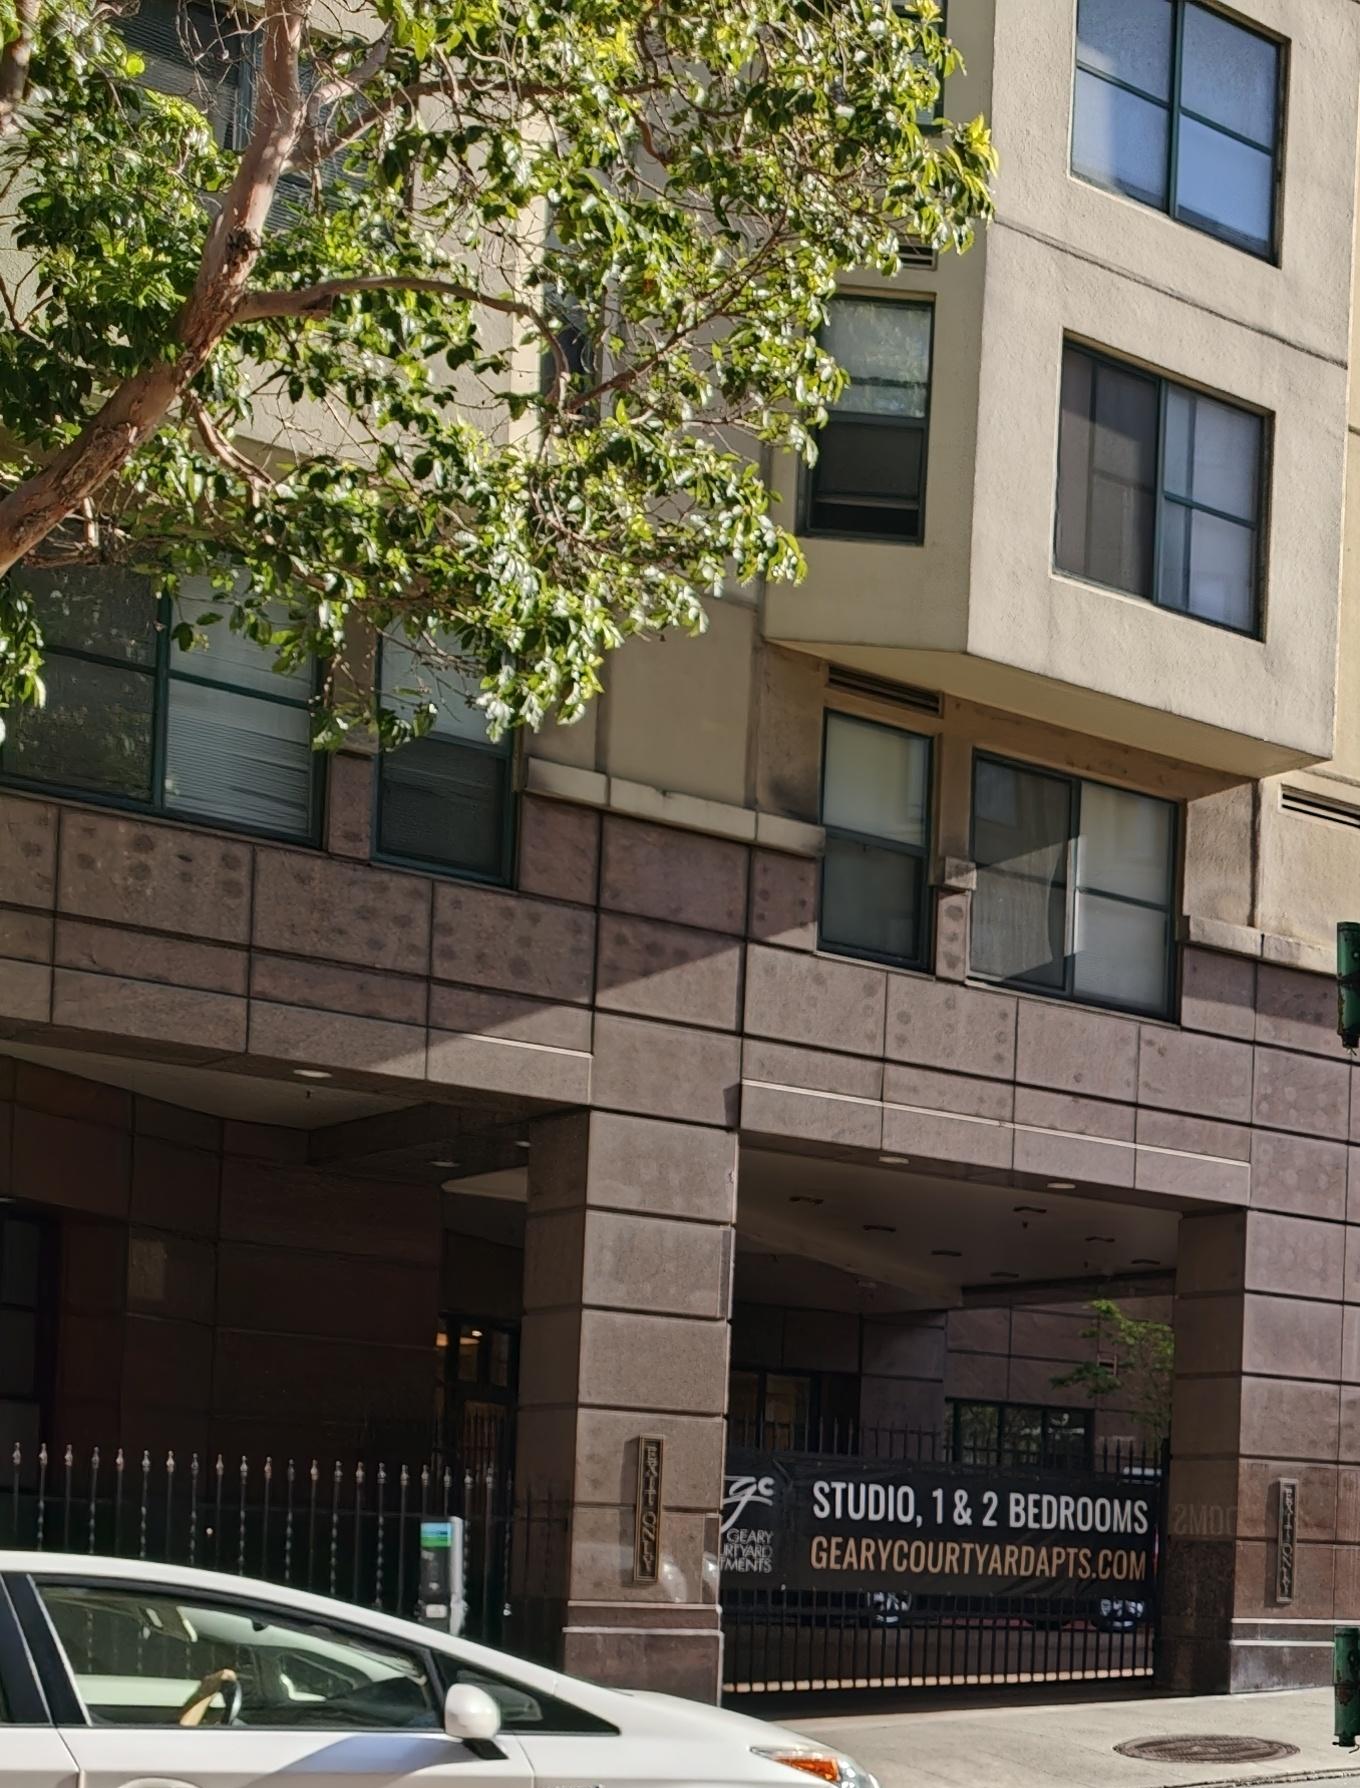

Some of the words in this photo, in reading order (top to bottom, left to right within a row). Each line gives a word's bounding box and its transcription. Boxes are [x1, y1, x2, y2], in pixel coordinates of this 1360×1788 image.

[812, 1480, 923, 1528] STUDIO,
[932, 1488, 943, 1524] 1
[953, 1489, 972, 1525] &
[982, 1491, 997, 1527] 2
[1009, 1492, 1148, 1534] BEDROOMS
[810, 1535, 1146, 1580] GEARYCOURTYARDAPTS.COM
